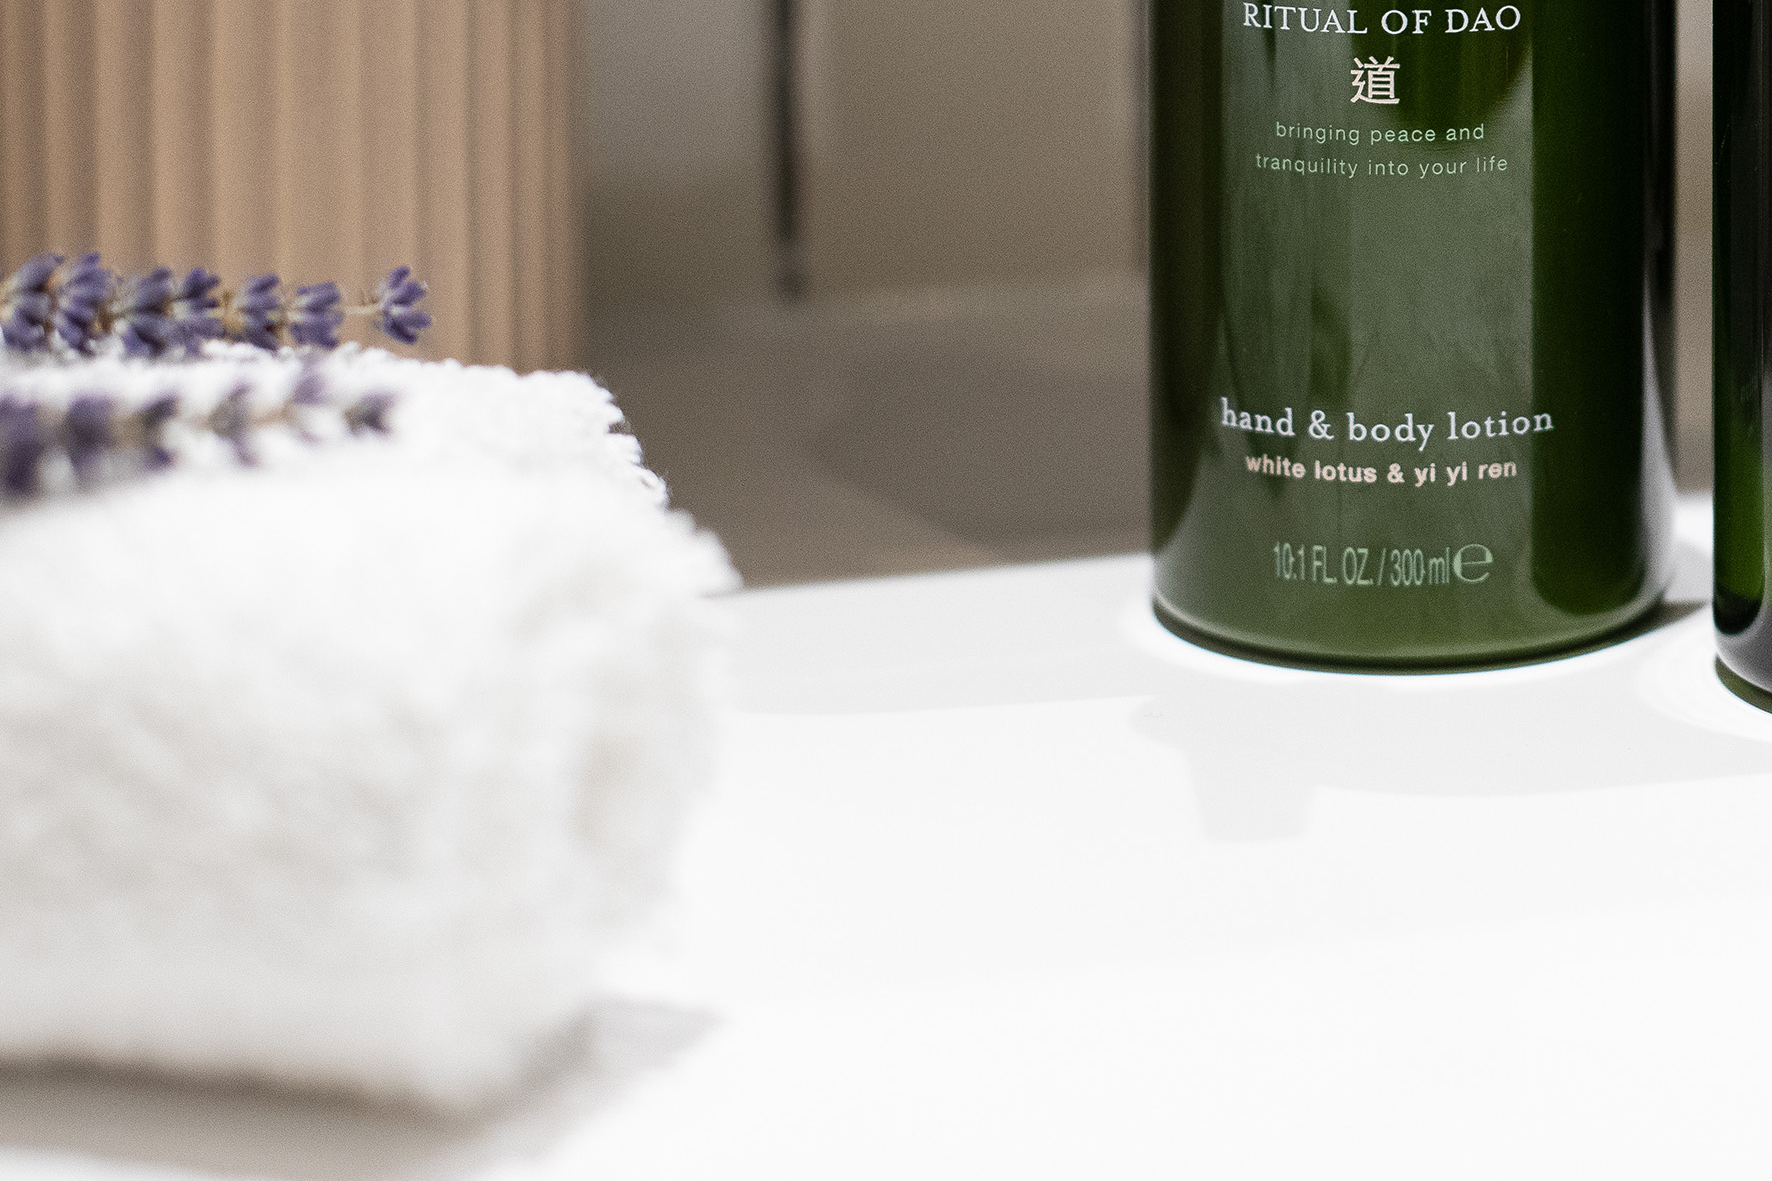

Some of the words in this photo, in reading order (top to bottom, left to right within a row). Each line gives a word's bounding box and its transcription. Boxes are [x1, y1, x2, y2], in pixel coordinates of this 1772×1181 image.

[1243, 2, 1369, 35] RITUAL
[1380, 8, 1433, 35] OF
[1444, 4, 1522, 34] DAO
[1350, 55, 1401, 105] 道
[1276, 121, 1360, 145] bringing
[1370, 126, 1436, 145] peace
[1446, 123, 1485, 141] and
[1255, 153, 1358, 178] tranquility
[1367, 159, 1409, 176] into
[1419, 161, 1467, 179] your
[1476, 155, 1508, 172] life
[1220, 396, 1296, 437] hand
[1308, 409, 1335, 441] &
[1346, 412, 1435, 452] body
[1447, 410, 1555, 441] lotion
[1245, 453, 1306, 479] white
[1314, 460, 1378, 483] lotus
[1386, 463, 1405, 483] &
[1414, 461, 1436, 487] yi
[1446, 460, 1469, 487] yi
[1478, 460, 1518, 480] ren
[1311, 544, 1338, 584] FL.
